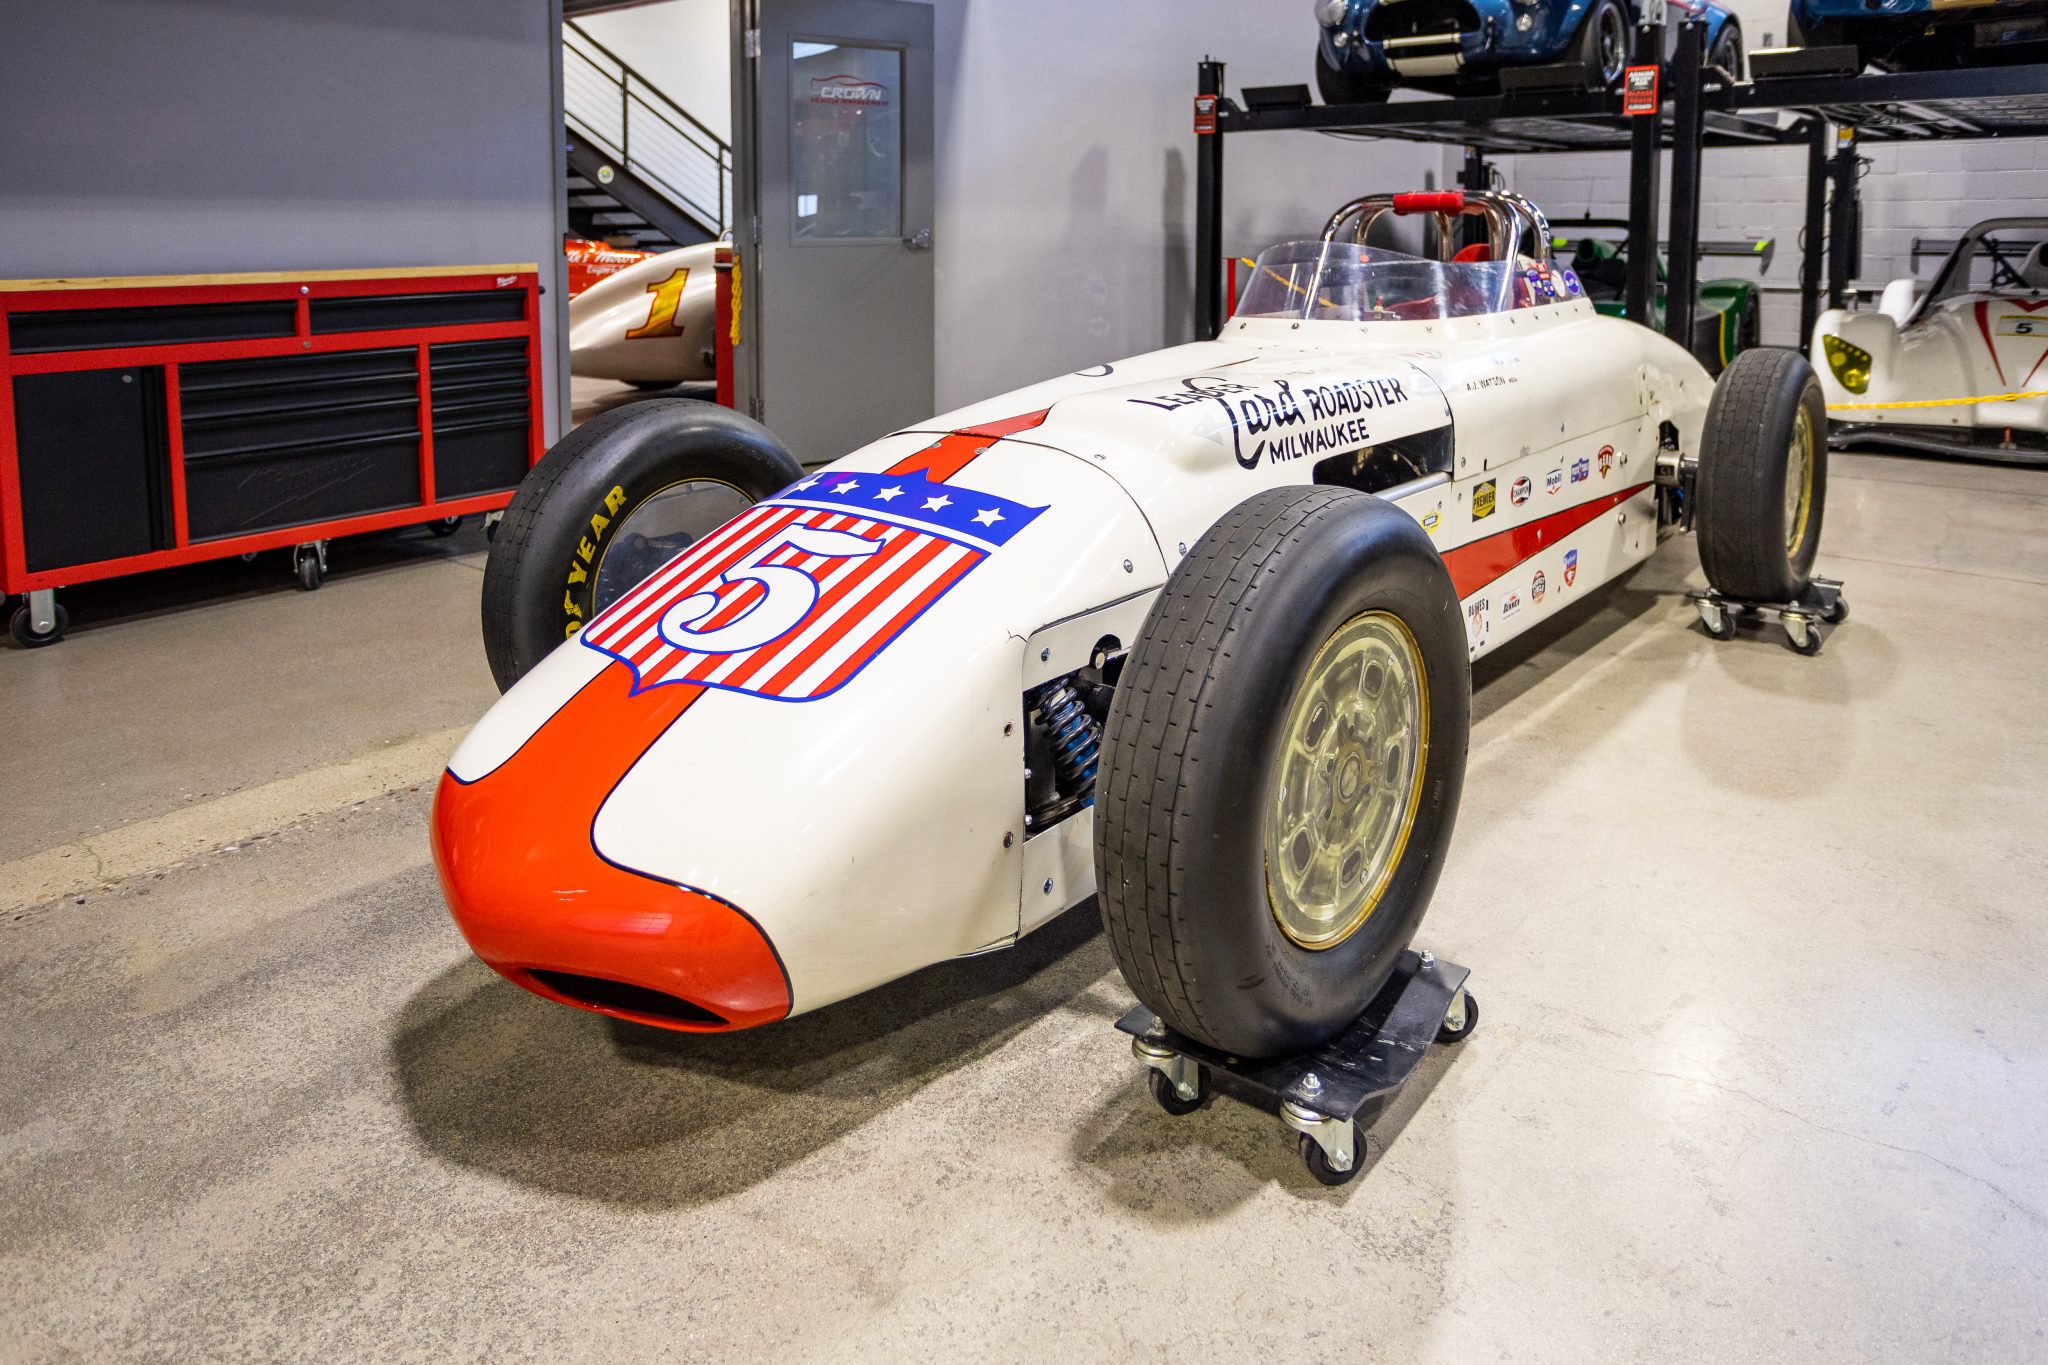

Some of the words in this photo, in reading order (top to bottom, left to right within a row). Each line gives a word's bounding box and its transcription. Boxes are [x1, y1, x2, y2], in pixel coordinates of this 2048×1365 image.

[821, 87, 882, 100] CROWN
[625, 268, 690, 339] 1
[2015, 322, 2033, 334] 5
[1479, 375, 1506, 389] WATSON
[1302, 376, 1408, 421] ROADSTER
[1269, 418, 1370, 464] MILWAUKEE
[1546, 473, 1561, 486] Mobil
[1473, 491, 1496, 510] PREMIER
[657, 522, 887, 655] 5
